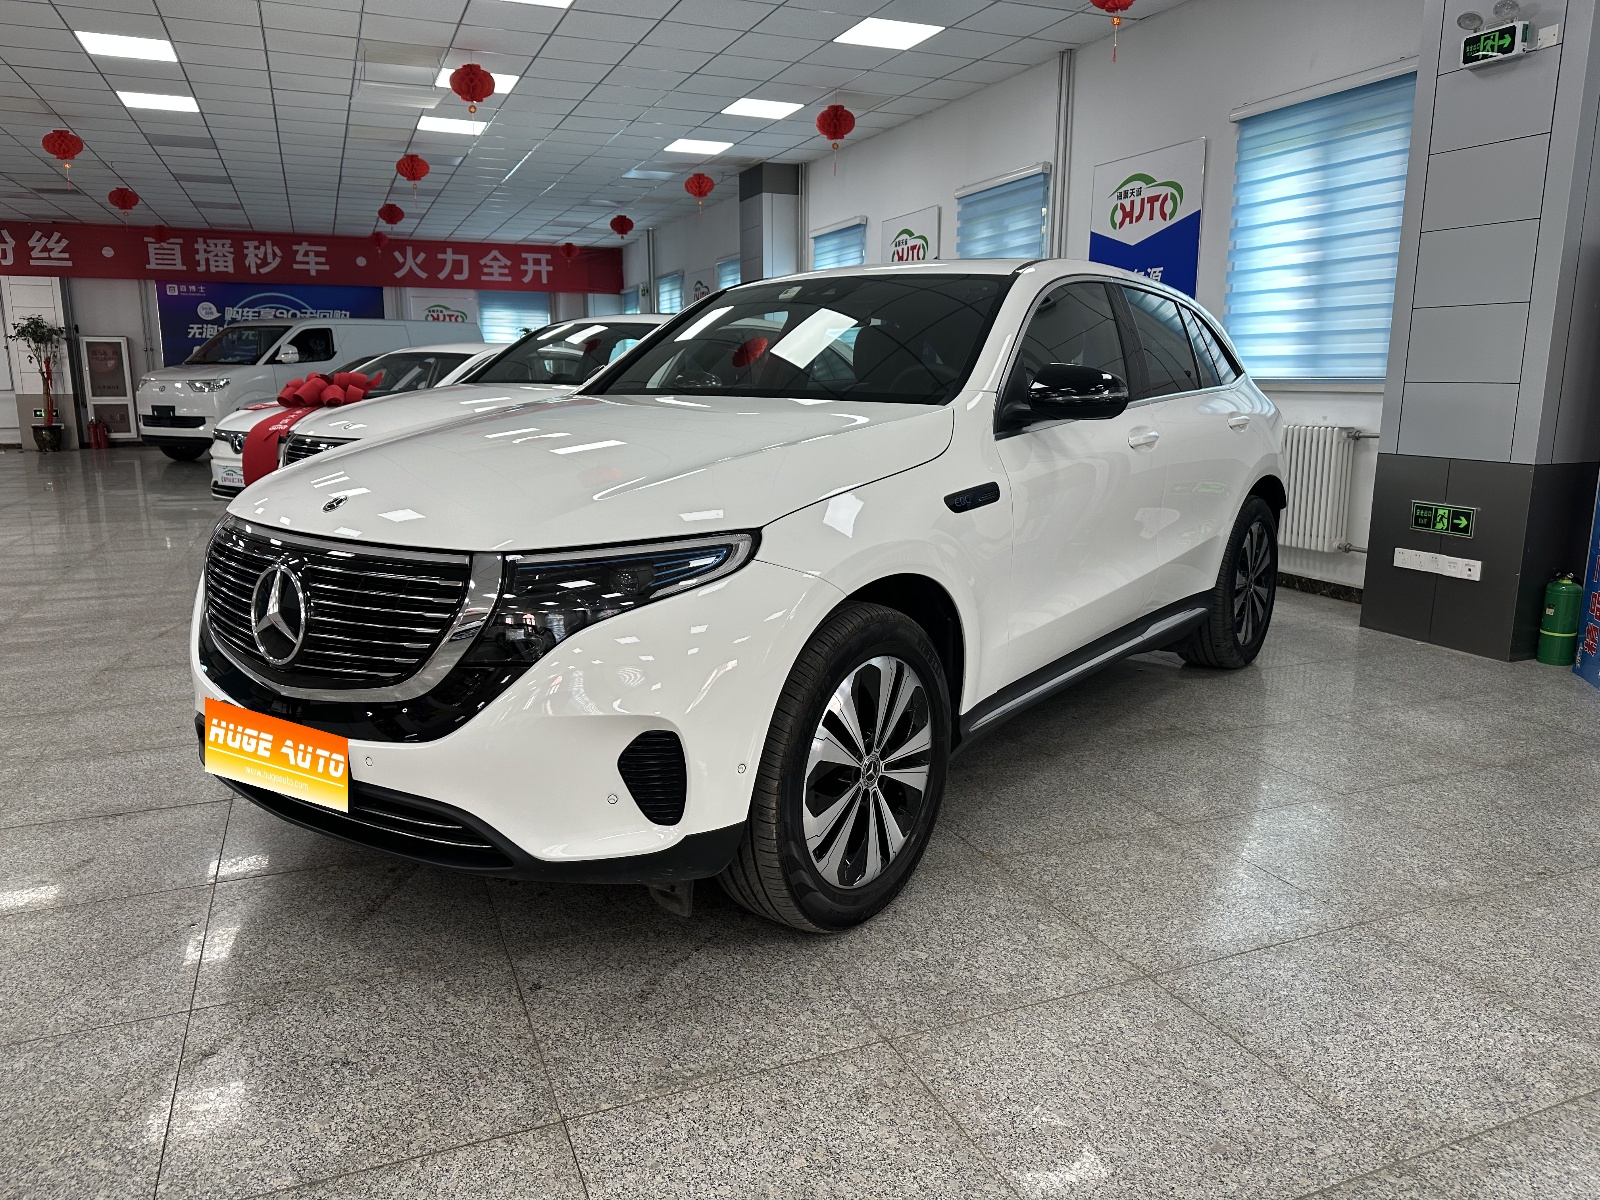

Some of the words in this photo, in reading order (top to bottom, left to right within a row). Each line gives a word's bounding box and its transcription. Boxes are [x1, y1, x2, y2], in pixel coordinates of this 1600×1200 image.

[143, 236, 330, 276] 直播秒车
[393, 245, 554, 284] 火力全开
